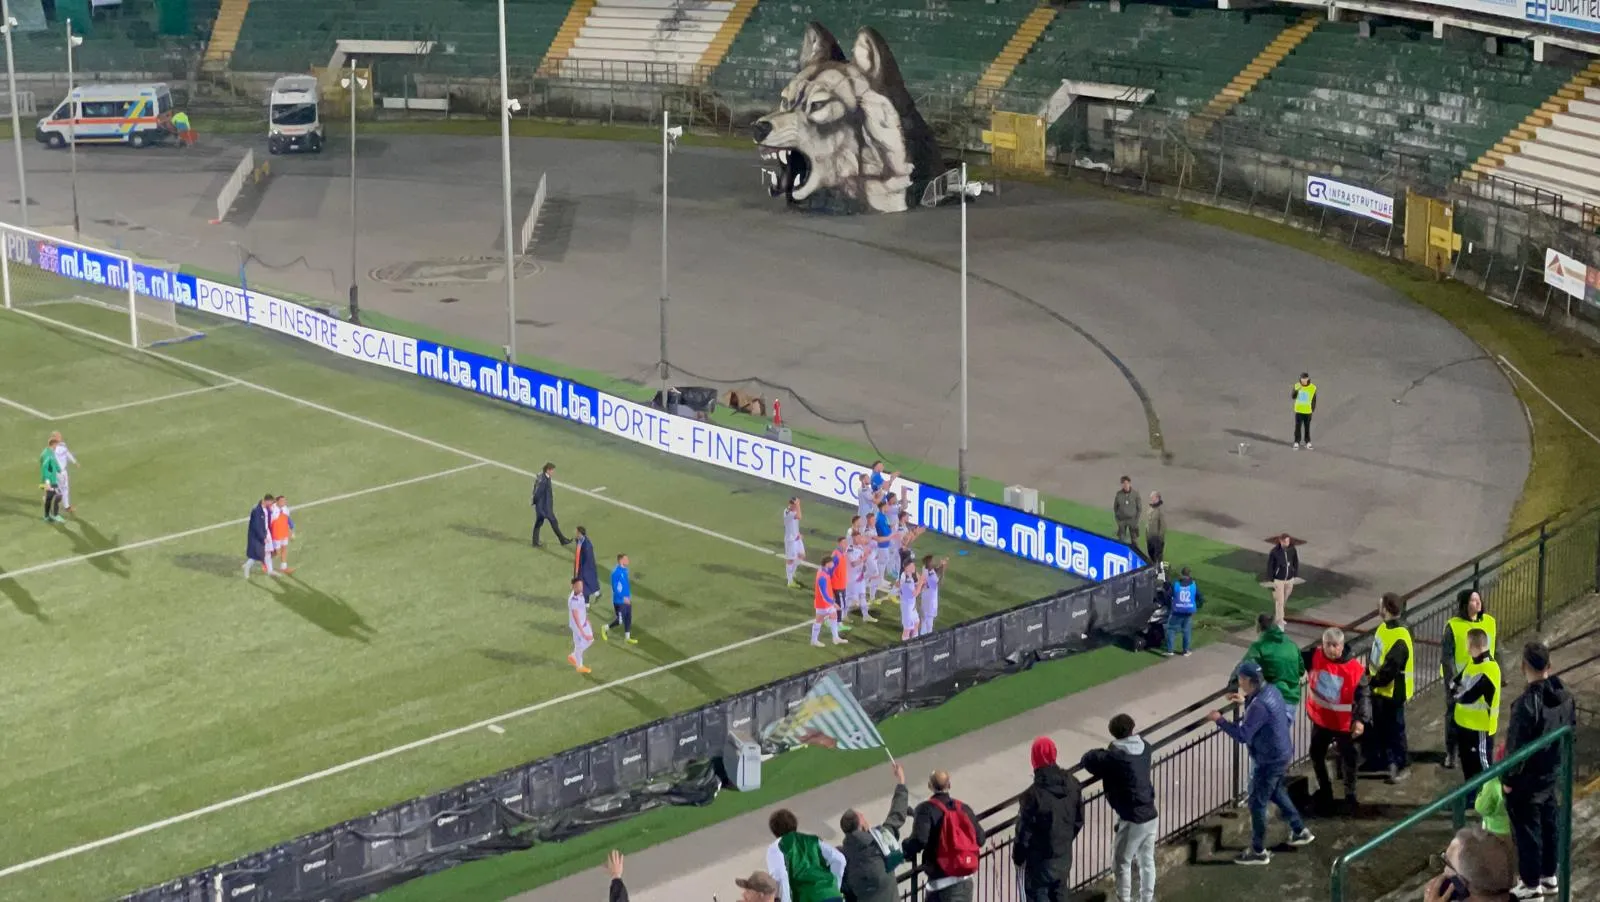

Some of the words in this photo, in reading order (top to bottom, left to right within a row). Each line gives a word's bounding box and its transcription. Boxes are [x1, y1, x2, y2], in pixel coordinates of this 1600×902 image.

[1329, 187, 1393, 214] INFRASTRUTTURE
[200, 283, 257, 319] PORTE
[269, 301, 338, 349] FINESTRE
[352, 330, 413, 368] SCALE
[420, 346, 477, 389] mi.ba.
[479, 362, 537, 407] mi.ba.
[539, 379, 597, 426] mi.ba.
[601, 399, 671, 447] PORTE
[692, 426, 812, 486] FINESTRE
[923, 495, 1006, 549] mi.ba.
[1011, 520, 1098, 579] mi.ba.
[1180, 590, 1192, 603] 02
